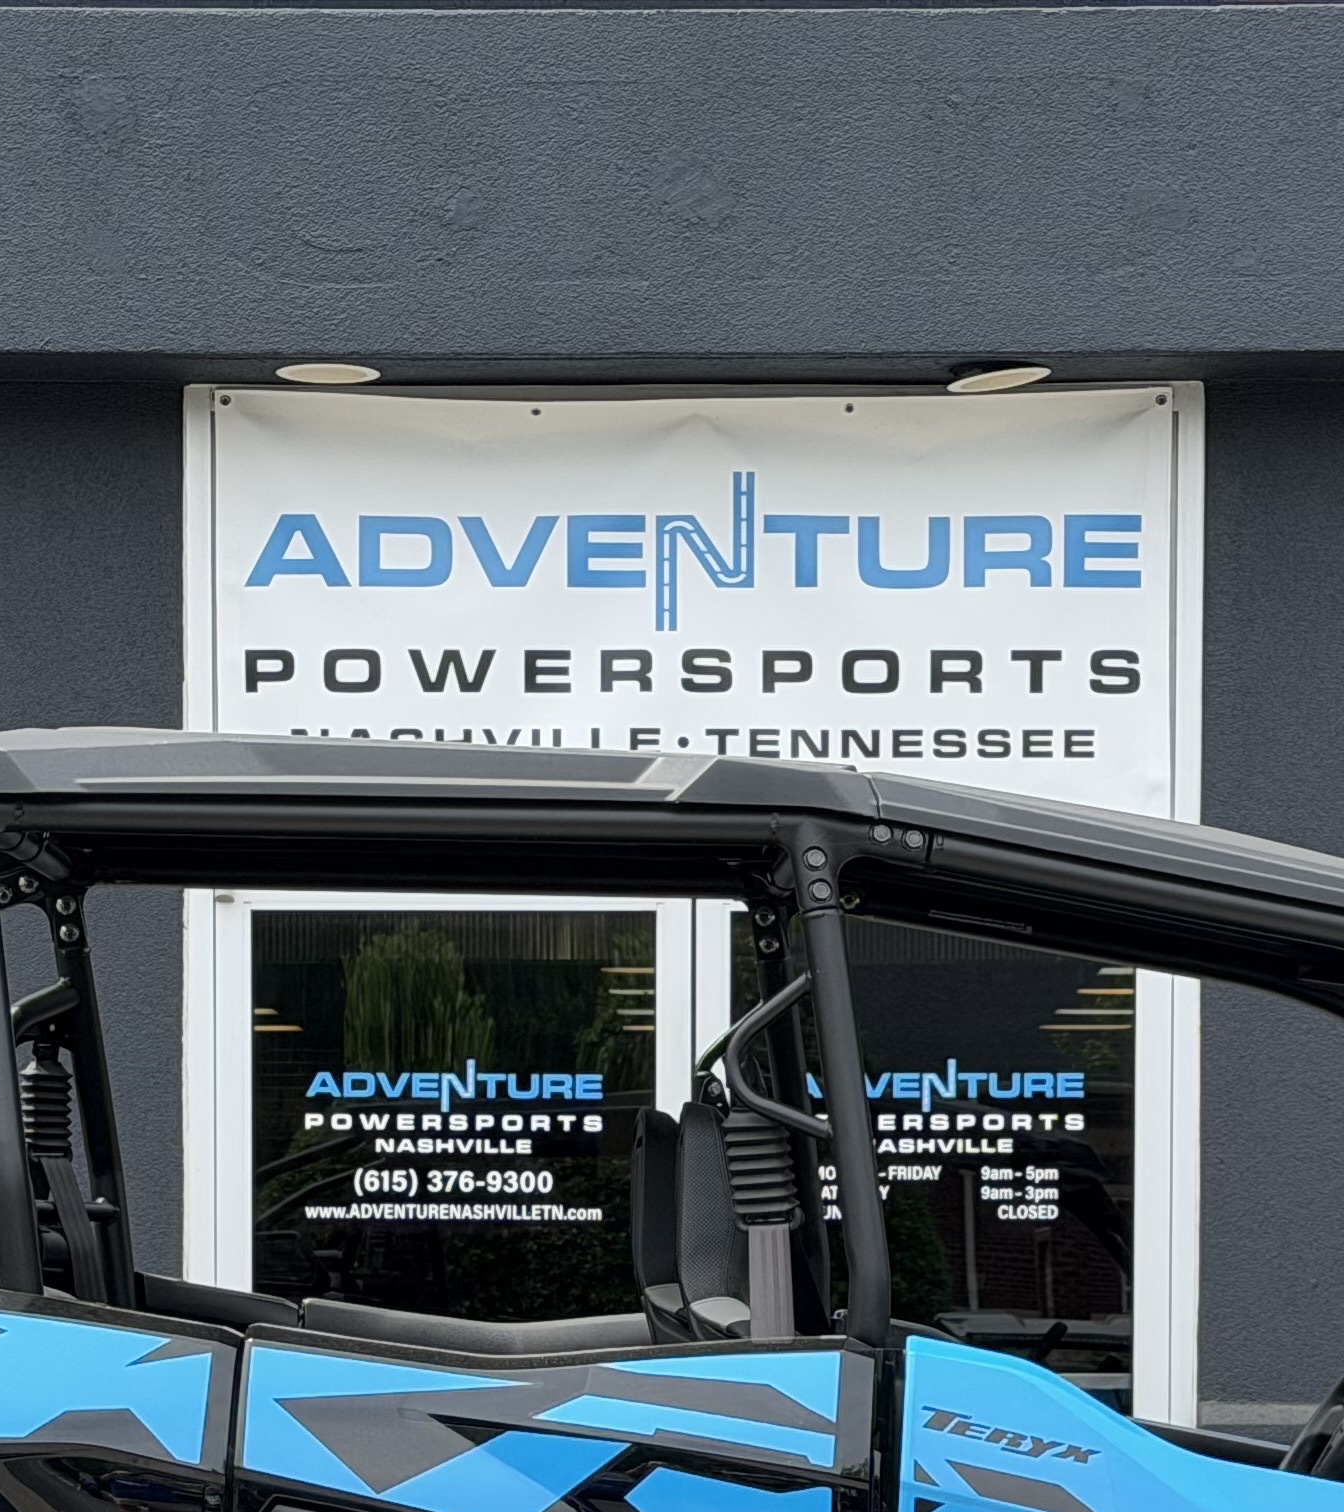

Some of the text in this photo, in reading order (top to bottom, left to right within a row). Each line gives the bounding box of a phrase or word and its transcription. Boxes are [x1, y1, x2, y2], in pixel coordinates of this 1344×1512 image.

[243, 470, 1143, 632] ADVENTURE
[244, 648, 1142, 695] POWERSPORTS
[705, 728, 1096, 759] TENNESSEE
[305, 1059, 604, 1113] ADVENTURE
[304, 1113, 604, 1132] POWERSPORTS
[816, 1114, 1085, 1131] ERSPORTS
[374, 1138, 533, 1154] NASHVILLE
[873, 1138, 1014, 1153] ASHVILLE
[353, 1168, 554, 1197] (615) 376-9300
[1025, 1165, 1059, 1184] 5pm
[1025, 1185, 1059, 1204] 3pm
[304, 1203, 604, 1222] www.ADVENTURENASHVILLETN.com
[997, 1204, 1059, 1220] CLOSED
